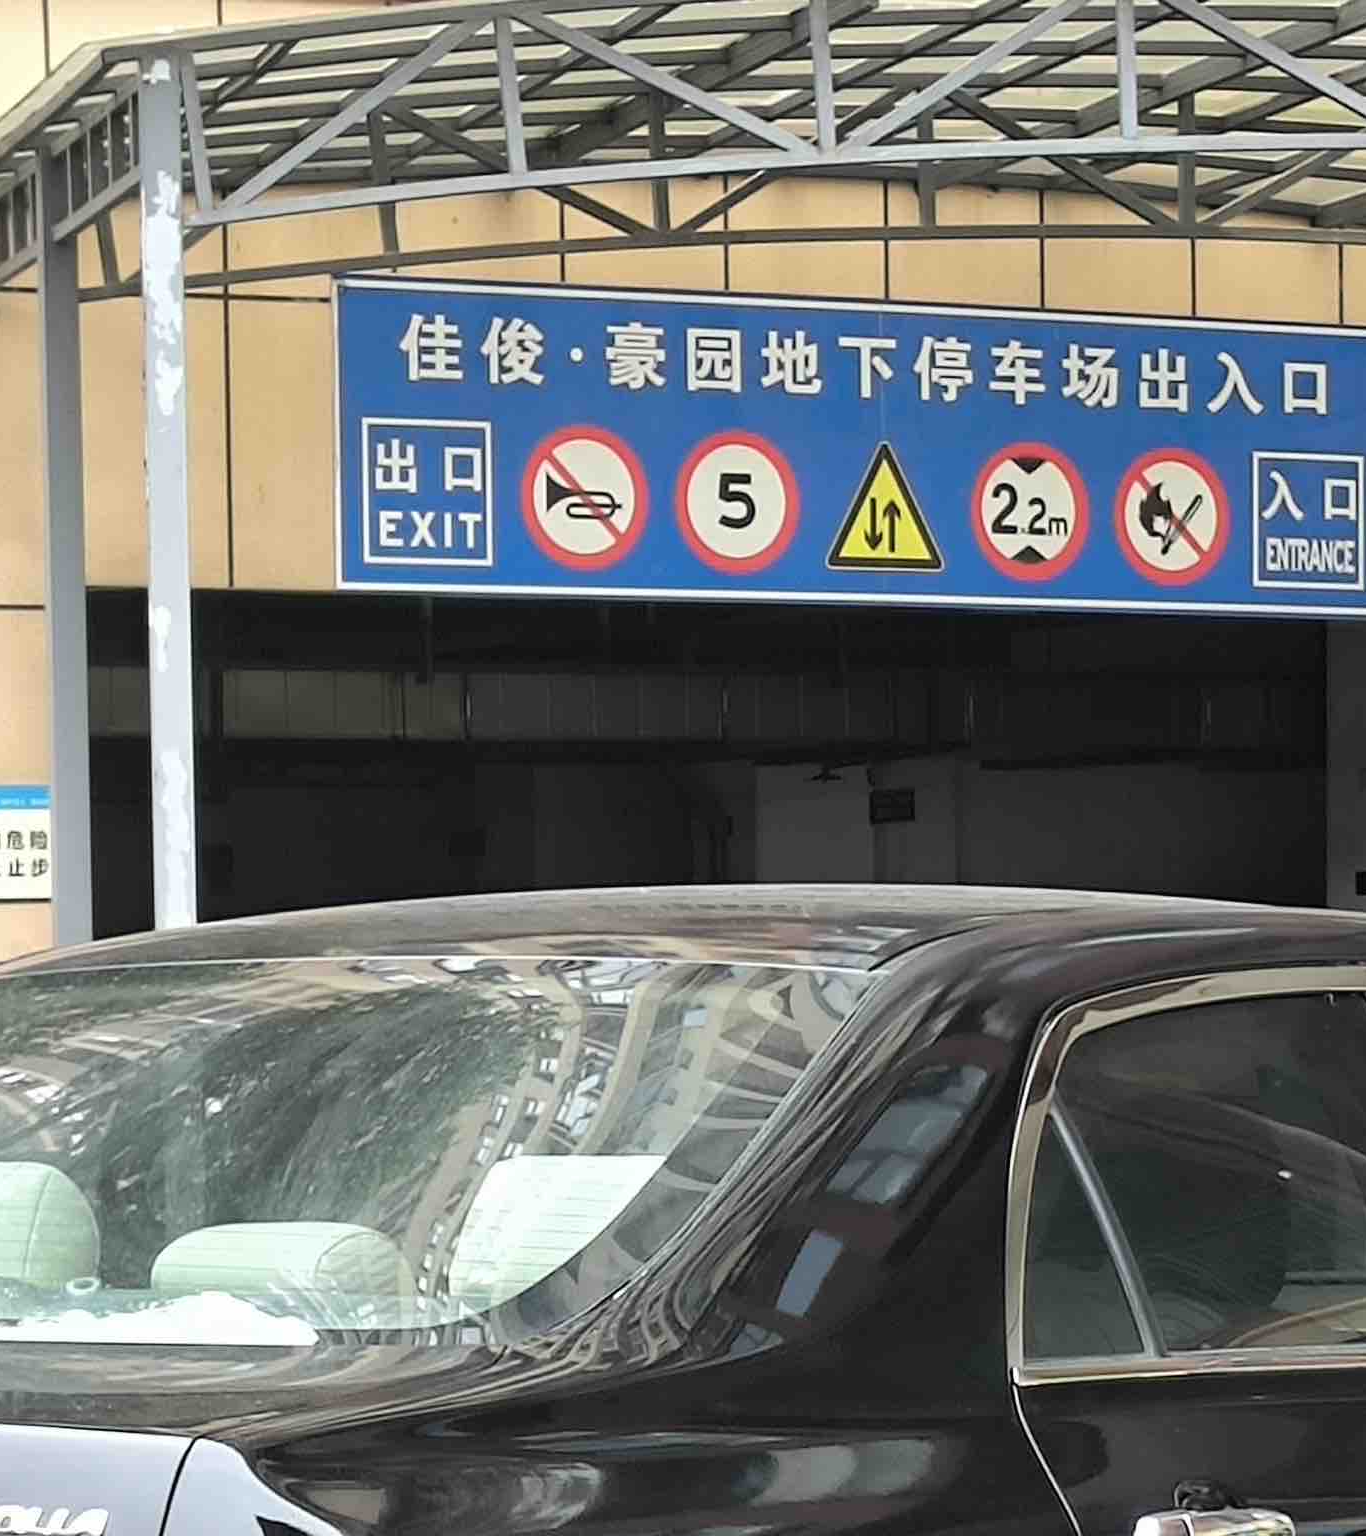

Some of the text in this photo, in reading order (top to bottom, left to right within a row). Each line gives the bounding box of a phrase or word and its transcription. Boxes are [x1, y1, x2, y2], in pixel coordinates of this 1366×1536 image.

[399, 313, 1328, 416] 佳俊·豪园地下停车场出入口
[374, 438, 483, 494] 出口
[718, 473, 756, 529] 5
[1262, 471, 1357, 521] 入口
[378, 511, 483, 549] EXIT
[1265, 537, 1356, 574] ENTRANCE
